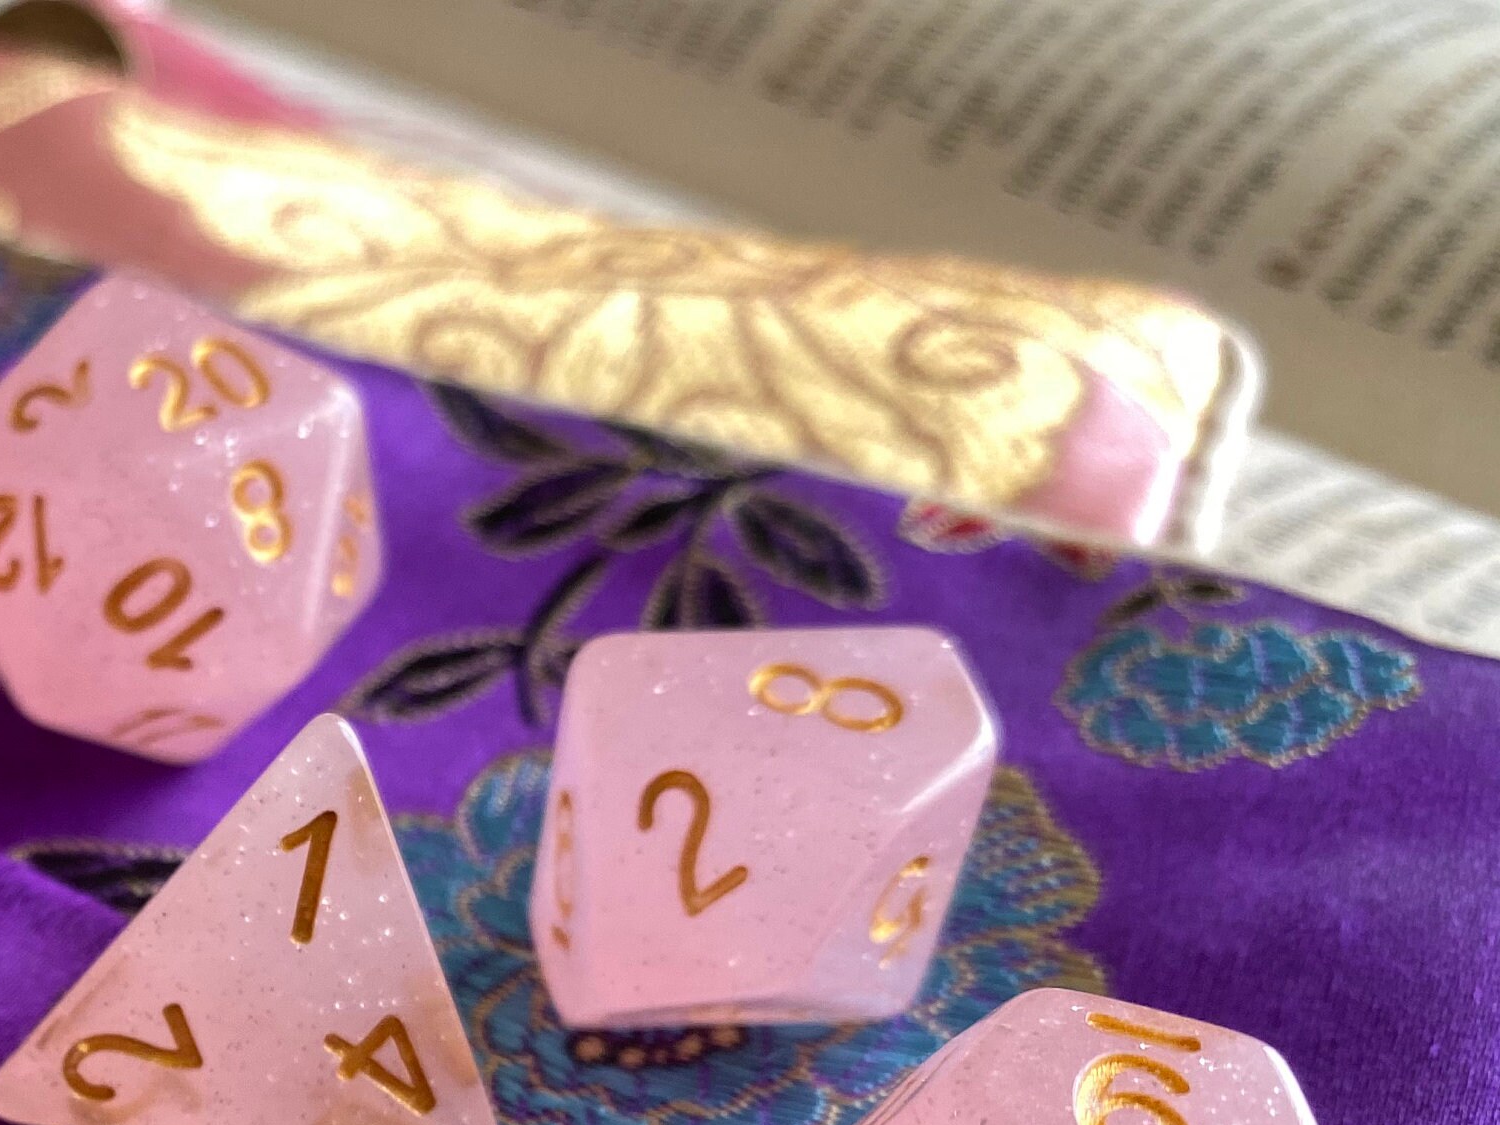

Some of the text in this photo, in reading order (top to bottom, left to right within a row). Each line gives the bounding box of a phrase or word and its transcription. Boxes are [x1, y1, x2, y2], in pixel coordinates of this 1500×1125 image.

[9, 357, 91, 434] 2
[127, 335, 270, 432] 20
[230, 459, 292, 565] 8
[102, 557, 226, 672] 10
[747, 662, 905, 734] 8
[279, 809, 338, 945] 1
[636, 769, 749, 917] 2
[61, 1002, 204, 1101] 2
[323, 1013, 437, 1117] 4
